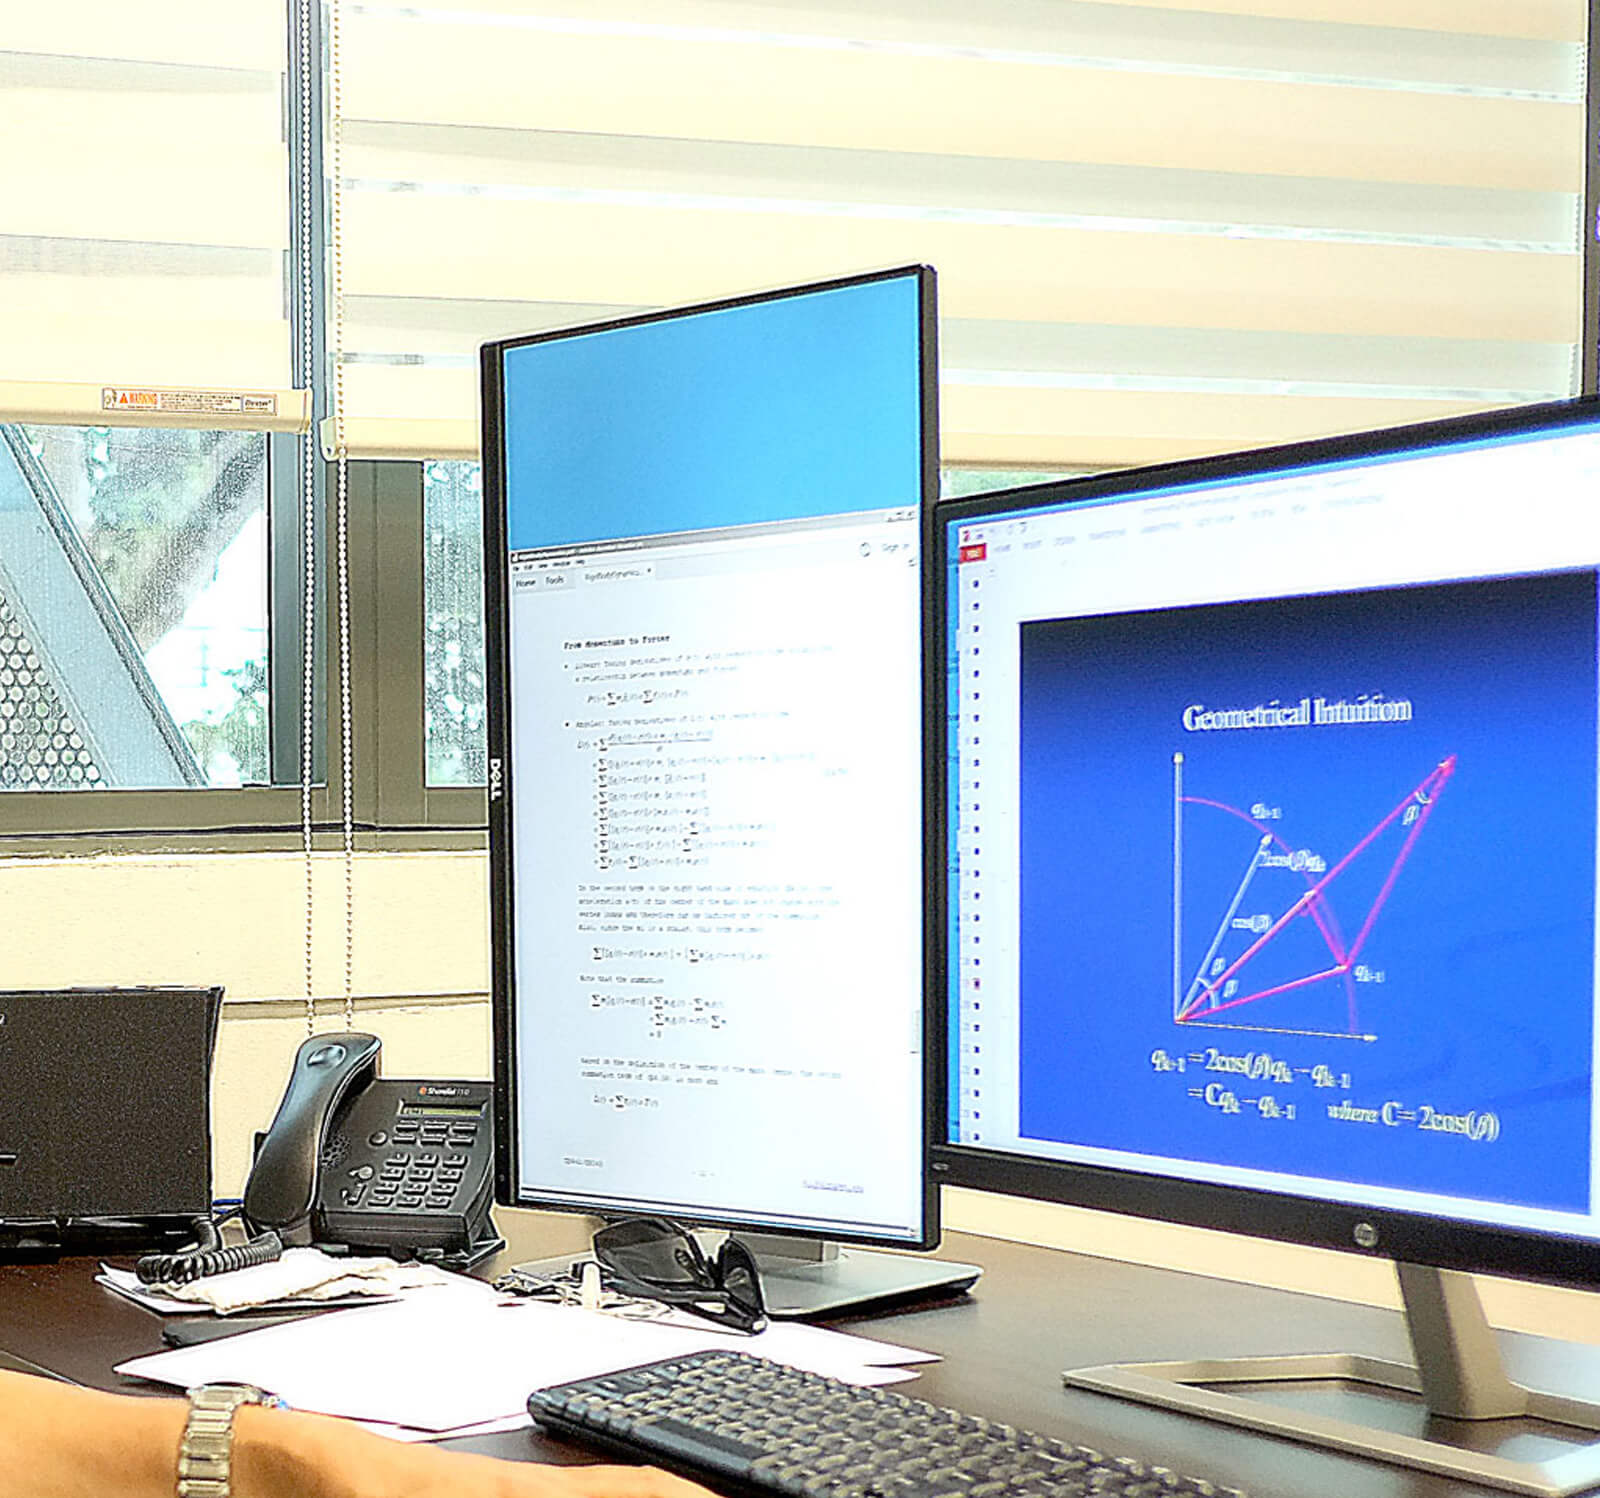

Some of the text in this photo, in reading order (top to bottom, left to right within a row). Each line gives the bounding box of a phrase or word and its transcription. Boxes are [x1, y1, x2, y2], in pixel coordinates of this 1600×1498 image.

[1183, 693, 1413, 732] Geometrical Intuition
[490, 759, 502, 801] DELL
[1327, 1100, 1379, 1123] where
